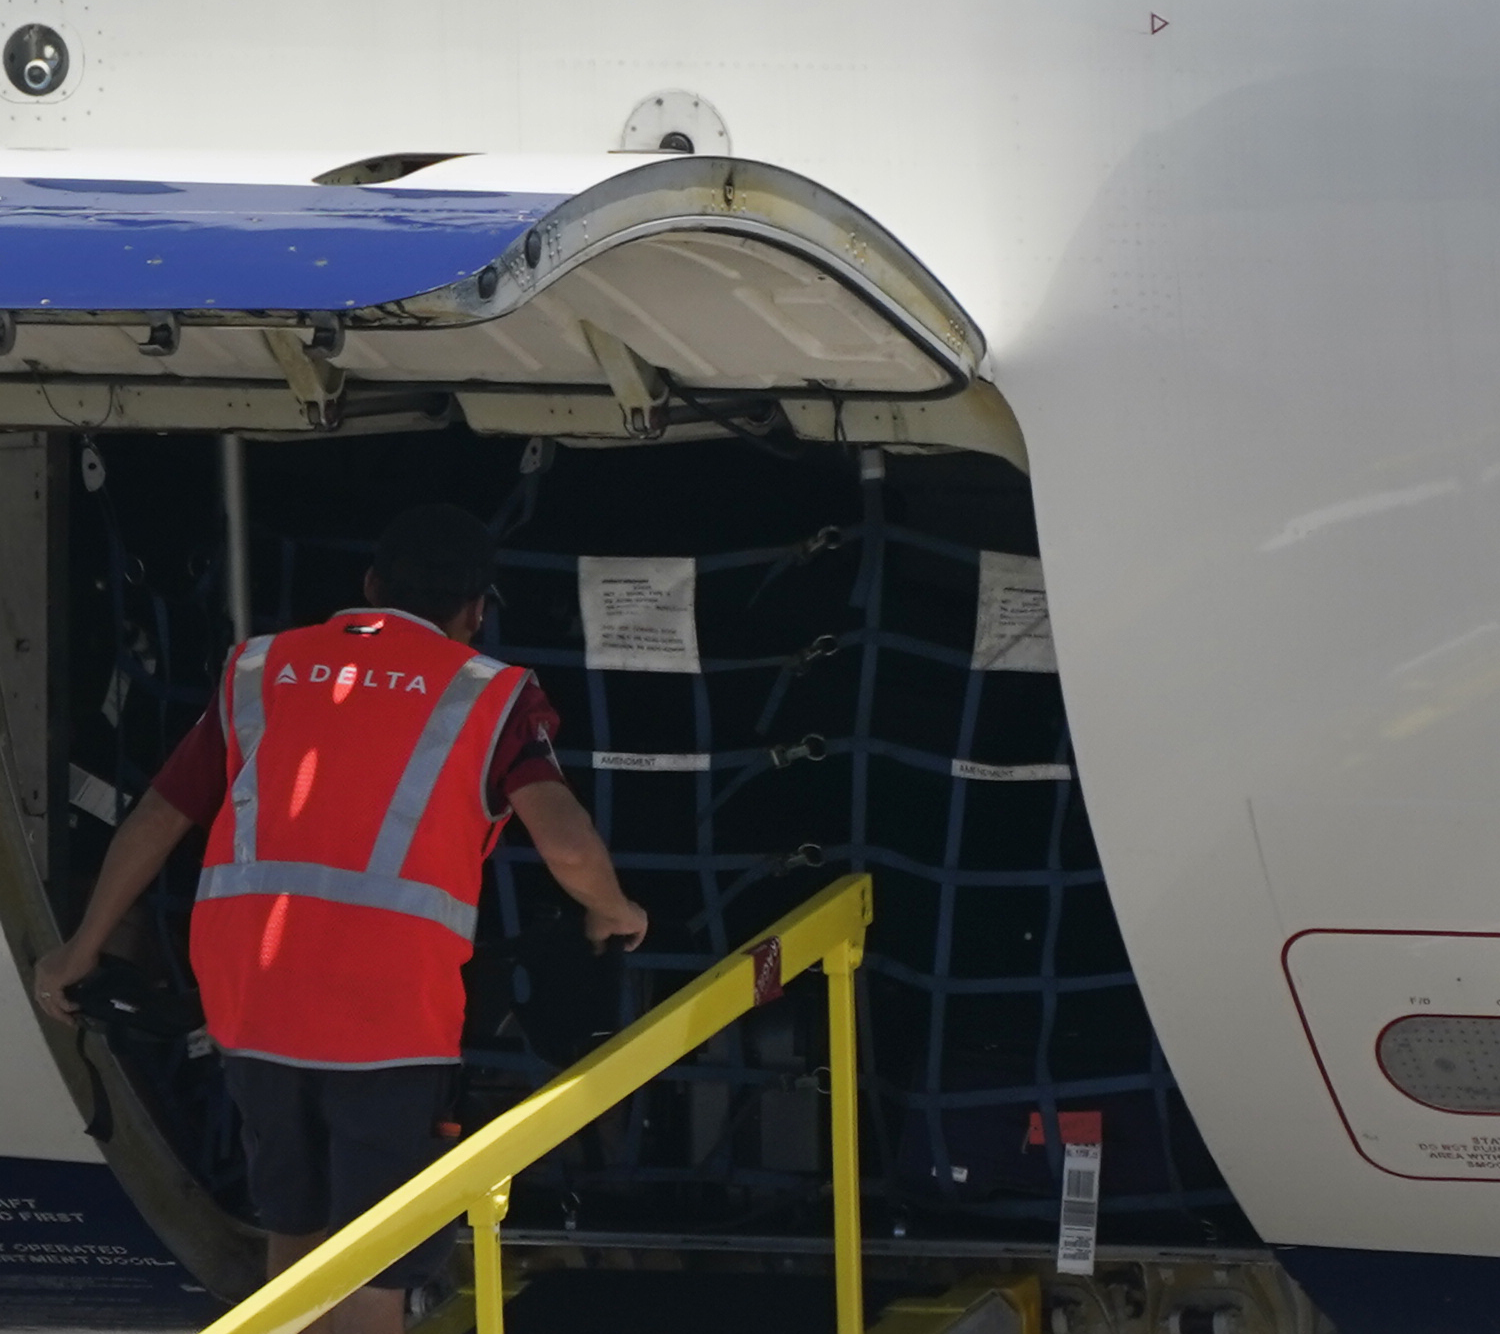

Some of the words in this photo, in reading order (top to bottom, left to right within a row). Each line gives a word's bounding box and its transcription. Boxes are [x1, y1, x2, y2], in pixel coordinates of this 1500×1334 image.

[309, 663, 427, 695] DELTA
[1418, 1143, 1438, 1151] DO
[1429, 1152, 1464, 1160] AREA
[19, 1212, 84, 1223] FIRST
[13, 1243, 127, 1255] OPERATED
